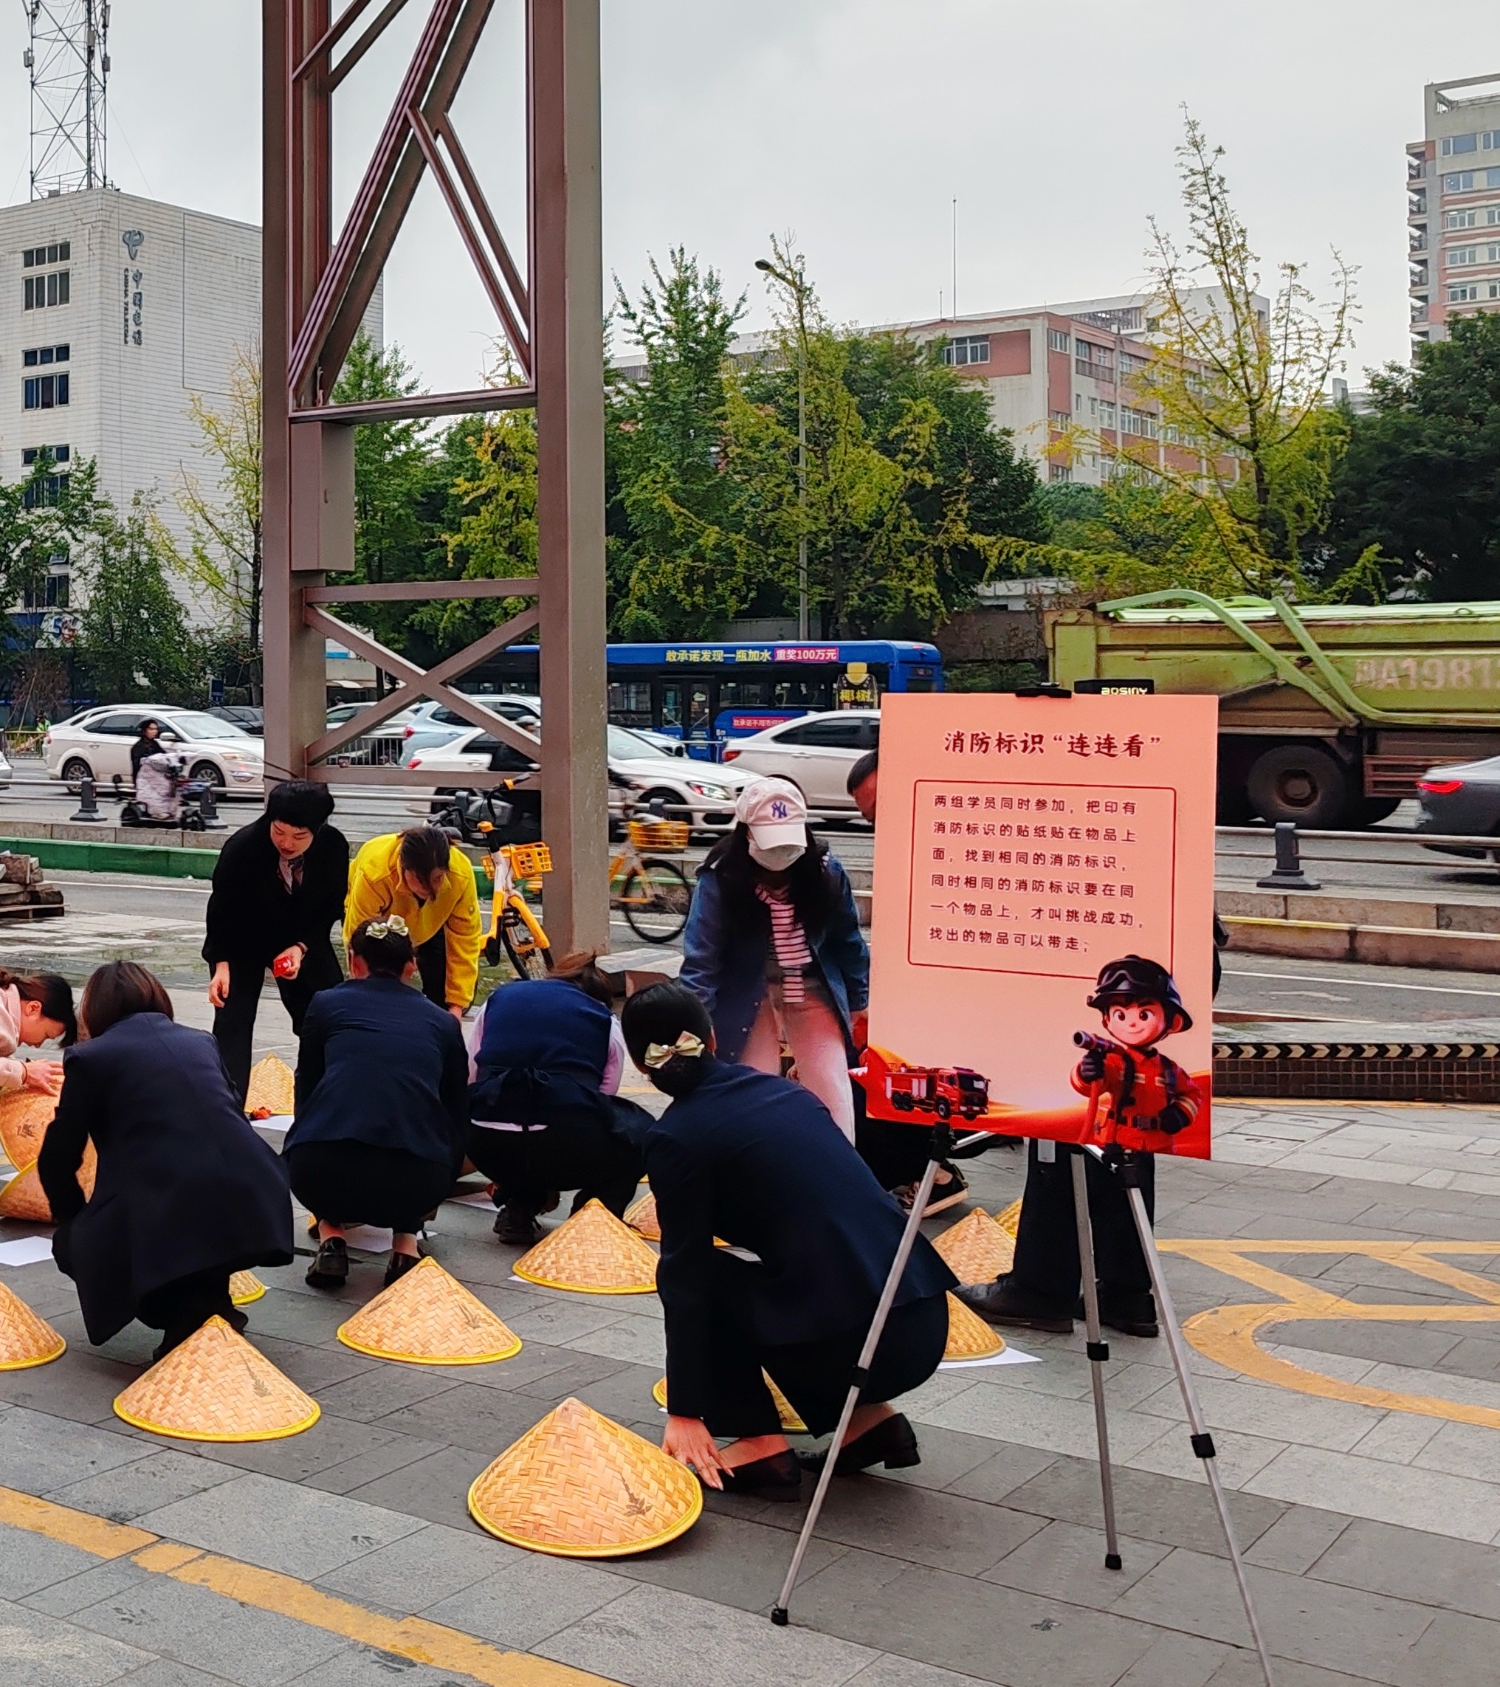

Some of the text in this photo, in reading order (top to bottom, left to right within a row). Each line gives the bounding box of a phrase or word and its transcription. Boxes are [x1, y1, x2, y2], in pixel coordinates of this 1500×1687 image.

[132, 268, 143, 346] 中国电信
[665, 649, 838, 663] 敢承诺发现一瓶加水 重奖100万元
[944, 730, 1162, 758] 消防标识“连连看”
[770, 800, 789, 819] NY
[934, 794, 1137, 816] 两组学员同时参加，把印有
[932, 820, 1138, 843] 消防标识的贴纸贴在物品上
[931, 874, 1135, 899] 同时相同的消防标识要在同
